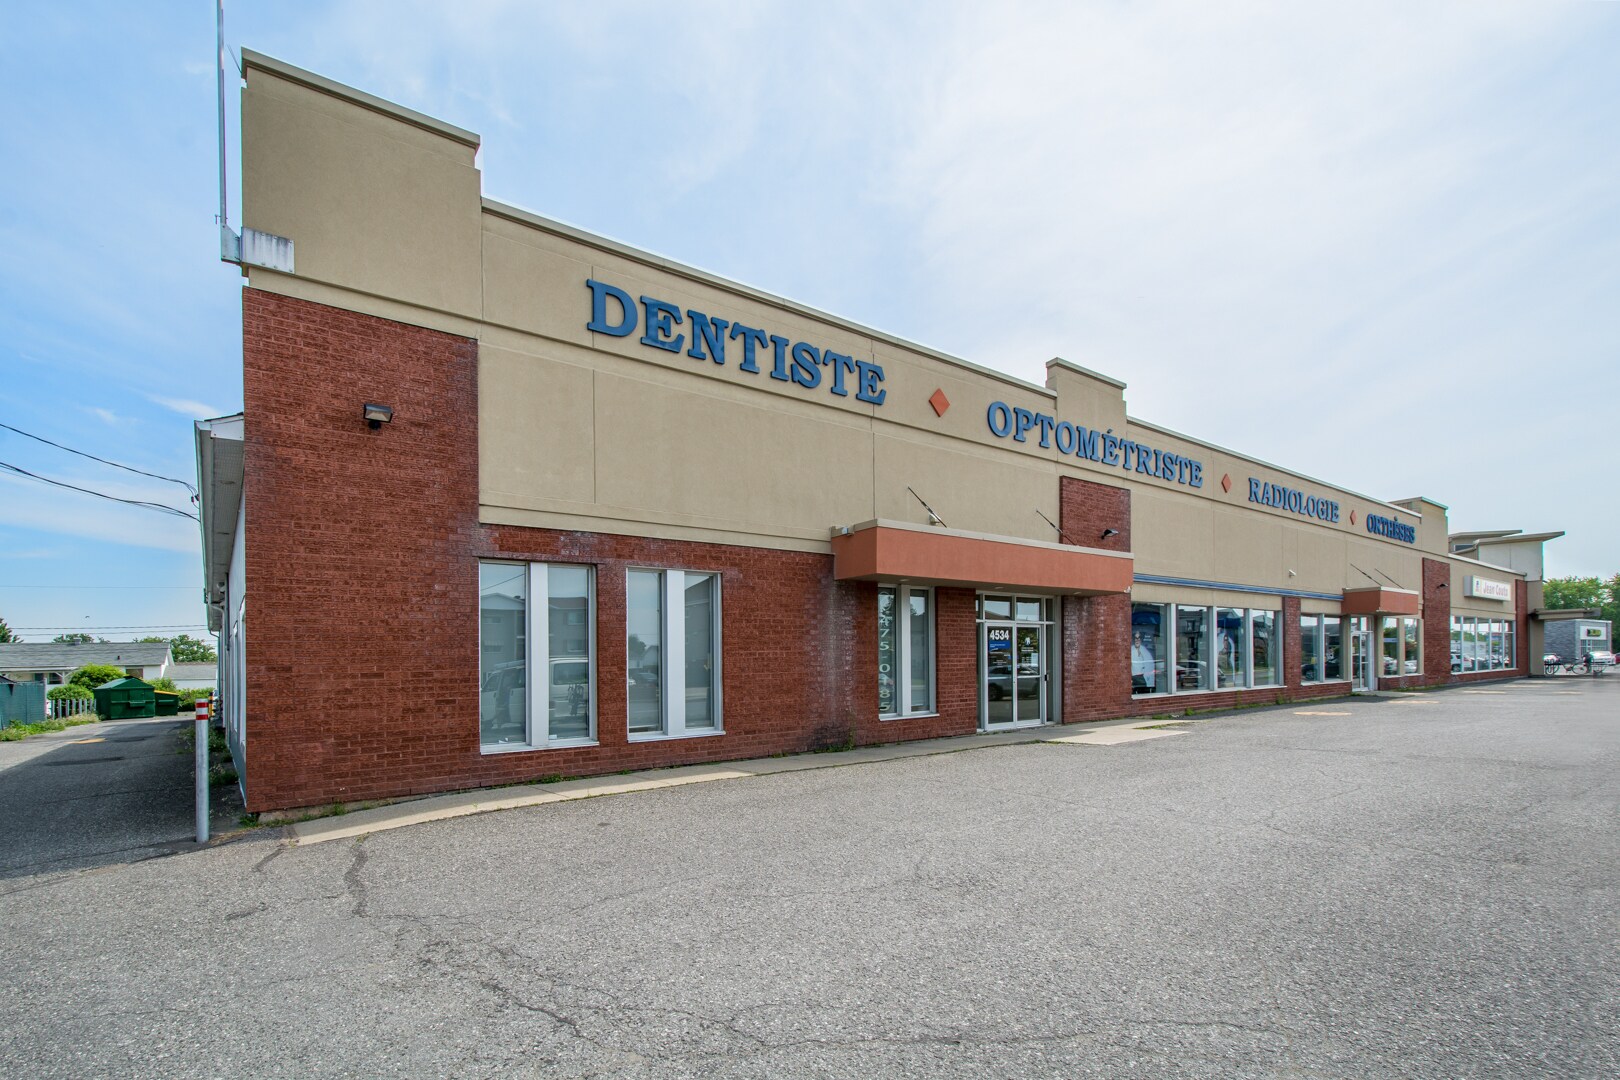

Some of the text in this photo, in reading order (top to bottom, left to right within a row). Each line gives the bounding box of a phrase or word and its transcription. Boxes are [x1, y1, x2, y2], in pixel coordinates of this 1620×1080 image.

[586, 278, 887, 405] DENTISTE
[987, 401, 1204, 488] OPTOMÉTRISTE
[1248, 477, 1340, 523] RADIOLOGIE
[990, 630, 1009, 640] 4534
